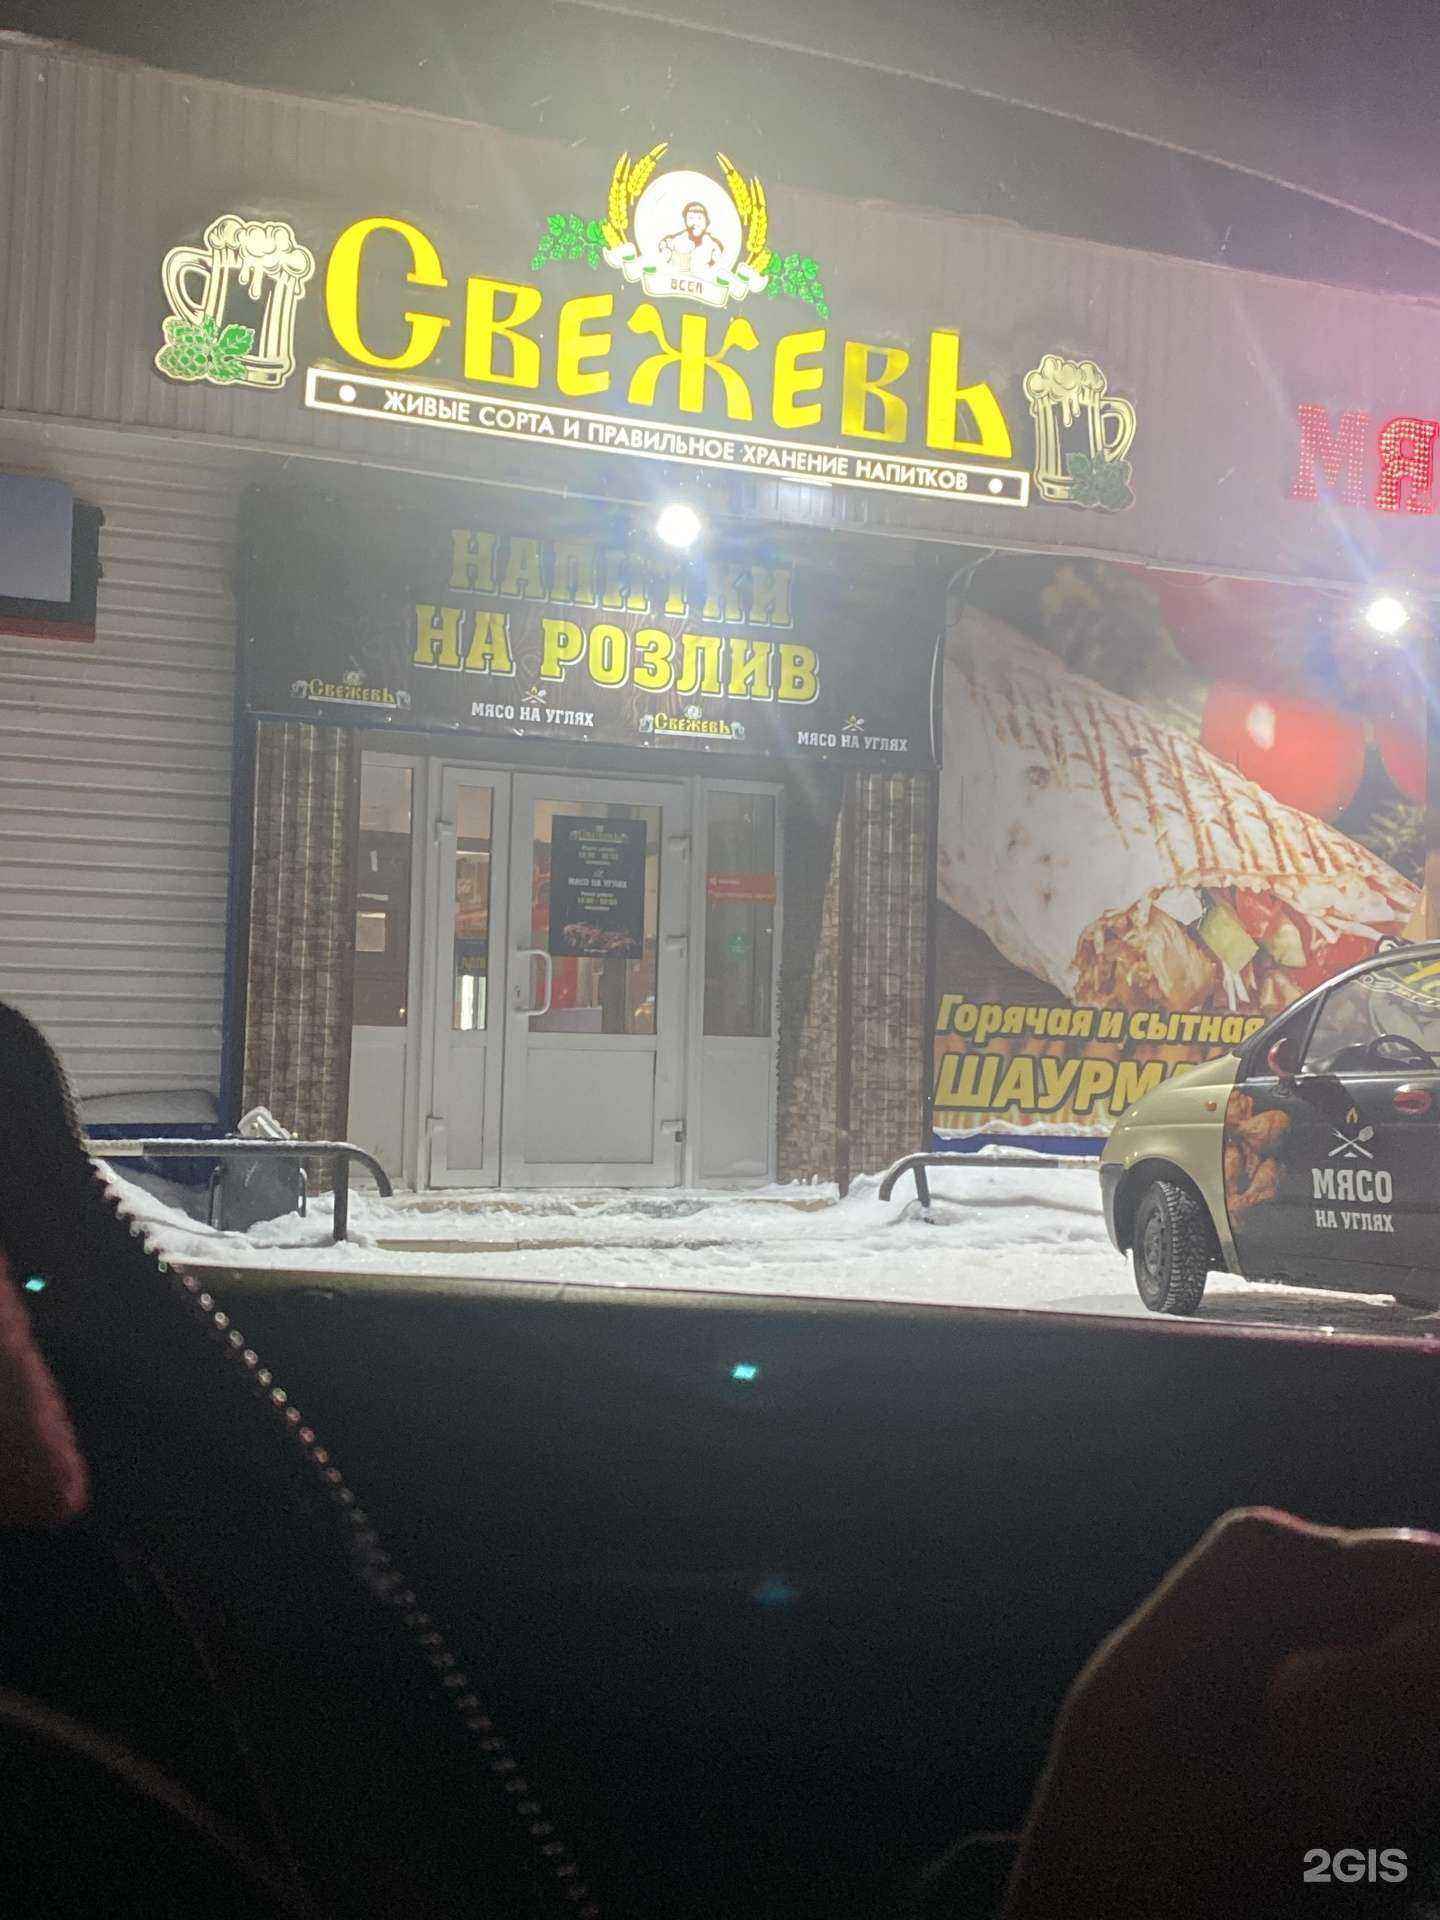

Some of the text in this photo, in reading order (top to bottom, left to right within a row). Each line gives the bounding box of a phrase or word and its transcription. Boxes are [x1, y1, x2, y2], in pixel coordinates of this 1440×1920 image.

[383, 389, 968, 492] ЖИВЫЕ СОРТА И ПРАВИЛЬНОЕ ХРАНЕНИЕ НАПИТКОВ
[412, 602, 821, 705] НА РОЗЛИВ
[471, 701, 595, 727] МЯСО НА УГЛЯХ
[797, 731, 910, 752] МЯСО НА УГЛЯХ
[935, 993, 1095, 1044] Горячая
[1097, 1010, 1125, 1040] и
[932, 1053, 1200, 1115] ШАУРМ
[1311, 1167, 1393, 1204] МЯСО
[1314, 1209, 1395, 1233] НА УГЛЯХ
